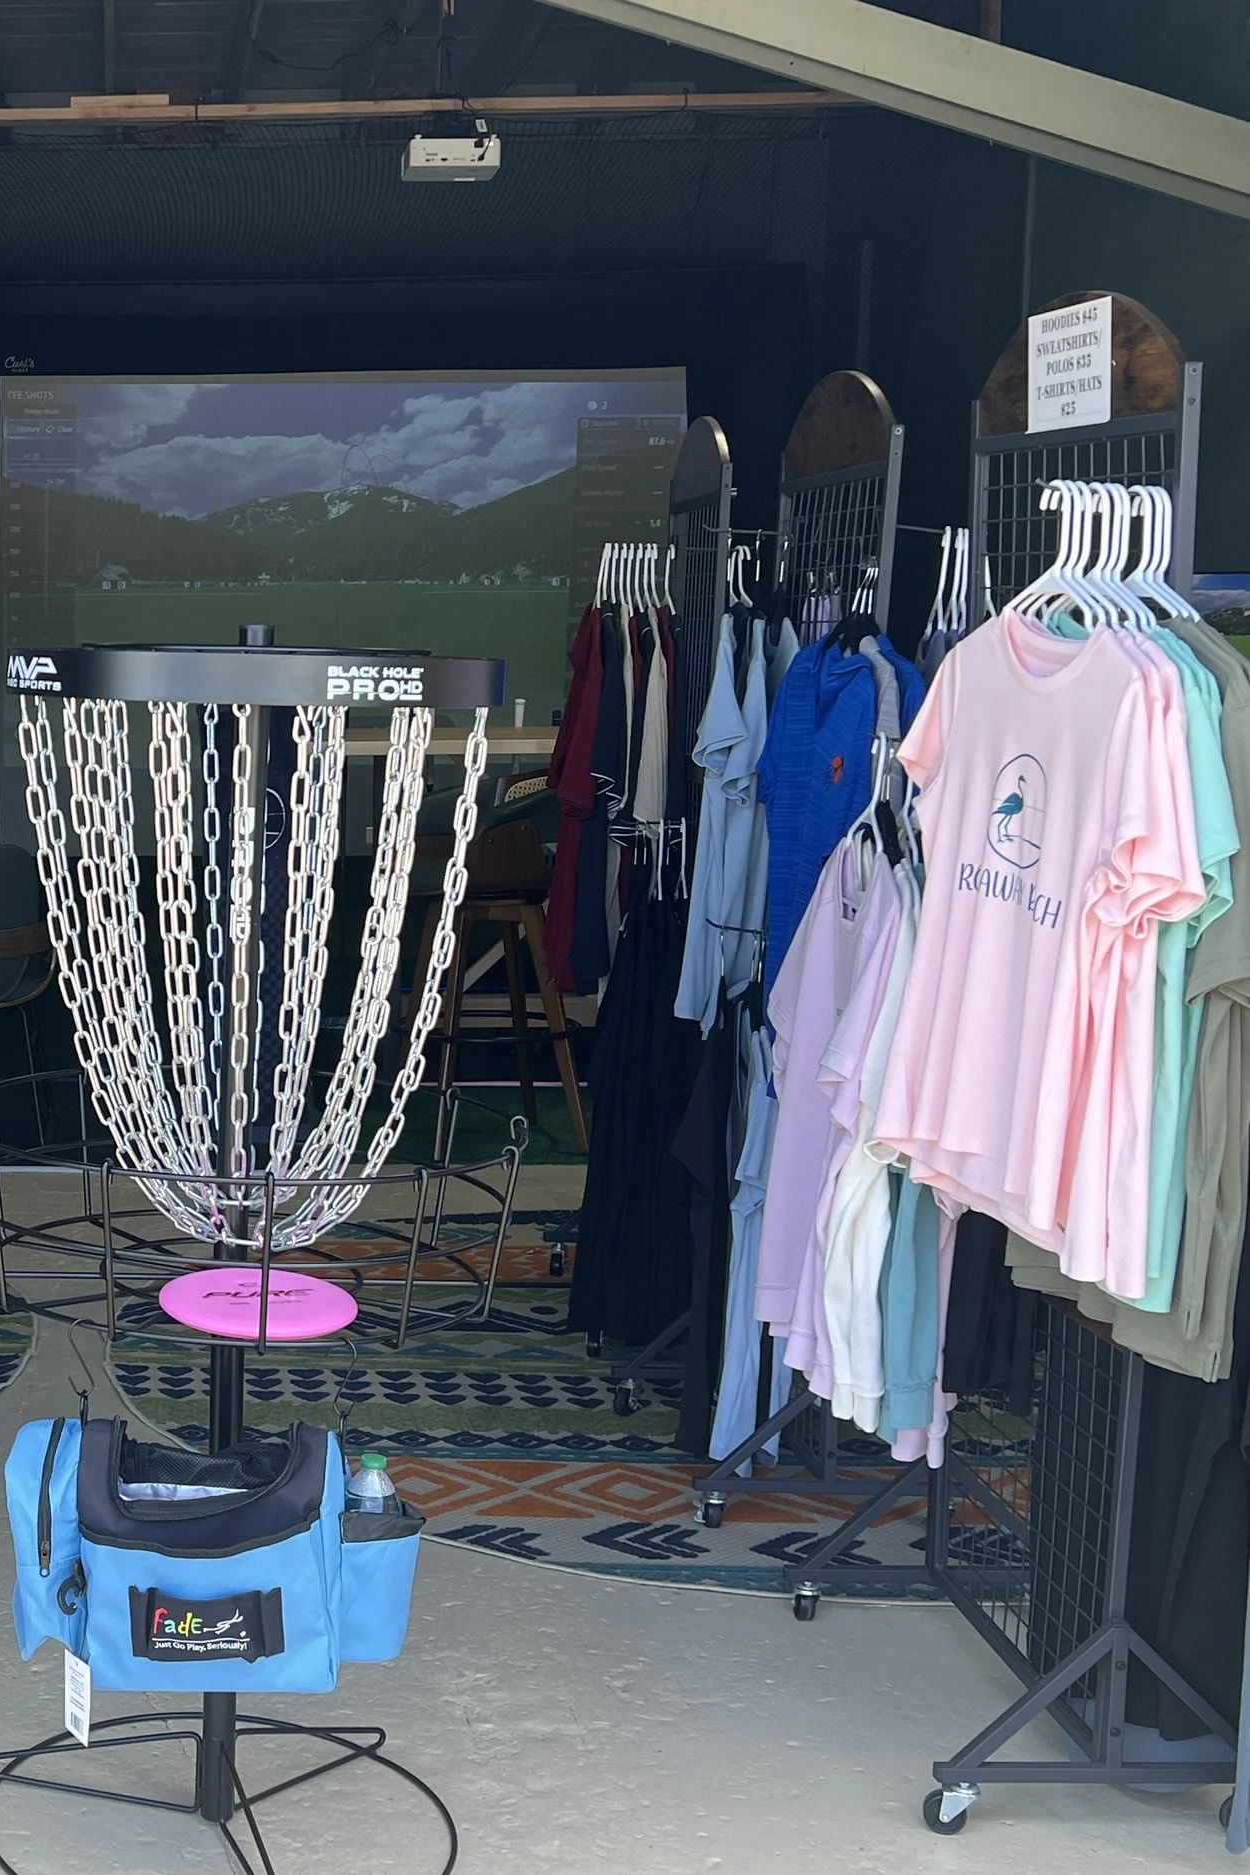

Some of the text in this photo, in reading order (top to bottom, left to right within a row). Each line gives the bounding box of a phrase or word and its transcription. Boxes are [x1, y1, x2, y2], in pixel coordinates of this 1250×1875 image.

[1041, 311, 1081, 334] HOODIES
[1036, 330, 1103, 358] SWEATSHIRTS/
[4, 356, 35, 369] Carl's
[1046, 359, 1075, 376] POLOS
[8, 391, 54, 400] TEE SHOTS
[1037, 375, 1103, 400] T-SHIRTS/HATS
[7, 655, 58, 680] MVP
[327, 665, 380, 678] BLACK
[19, 679, 62, 692] SPORTS
[326, 678, 423, 700] PRO HD
[154, 1641, 172, 1649] Just
[173, 1642, 185, 1650] Go
[207, 1641, 248, 1651] Seriously!
